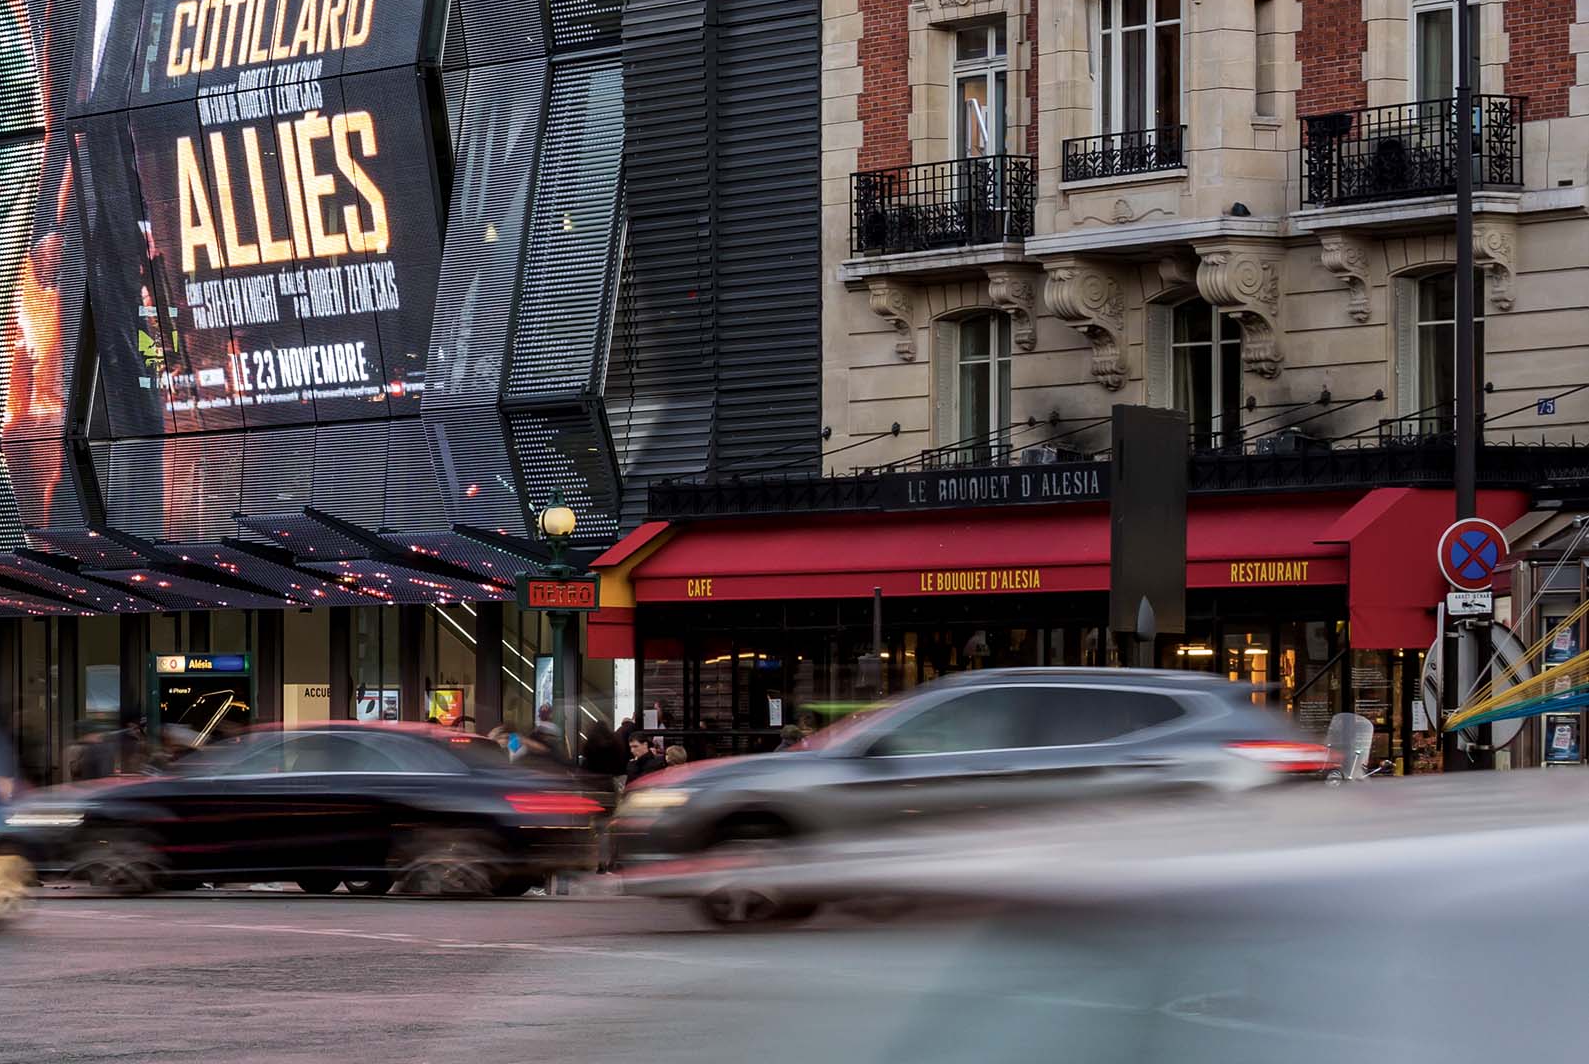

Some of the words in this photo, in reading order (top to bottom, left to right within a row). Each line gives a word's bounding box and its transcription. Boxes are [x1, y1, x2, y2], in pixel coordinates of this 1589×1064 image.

[175, 109, 390, 273] ALLIÉS
[307, 266, 347, 318] ROBERT
[344, 260, 400, 314] ZEMECKIS
[203, 276, 244, 329] STEVEN
[239, 274, 280, 325] KNIGHT
[229, 352, 253, 391] LE
[253, 350, 277, 390] 23
[277, 342, 369, 388] NOVEMBRE
[1539, 400, 1553, 413] 75
[908, 479, 927, 503] LE
[921, 573, 933, 591] LE
[937, 571, 987, 591] BOUQUET
[991, 569, 1040, 589] D'ALESIA
[1231, 561, 1309, 583] RESTAURANT
[687, 579, 712, 597] CAFE
[188, 659, 213, 669] Alésia
